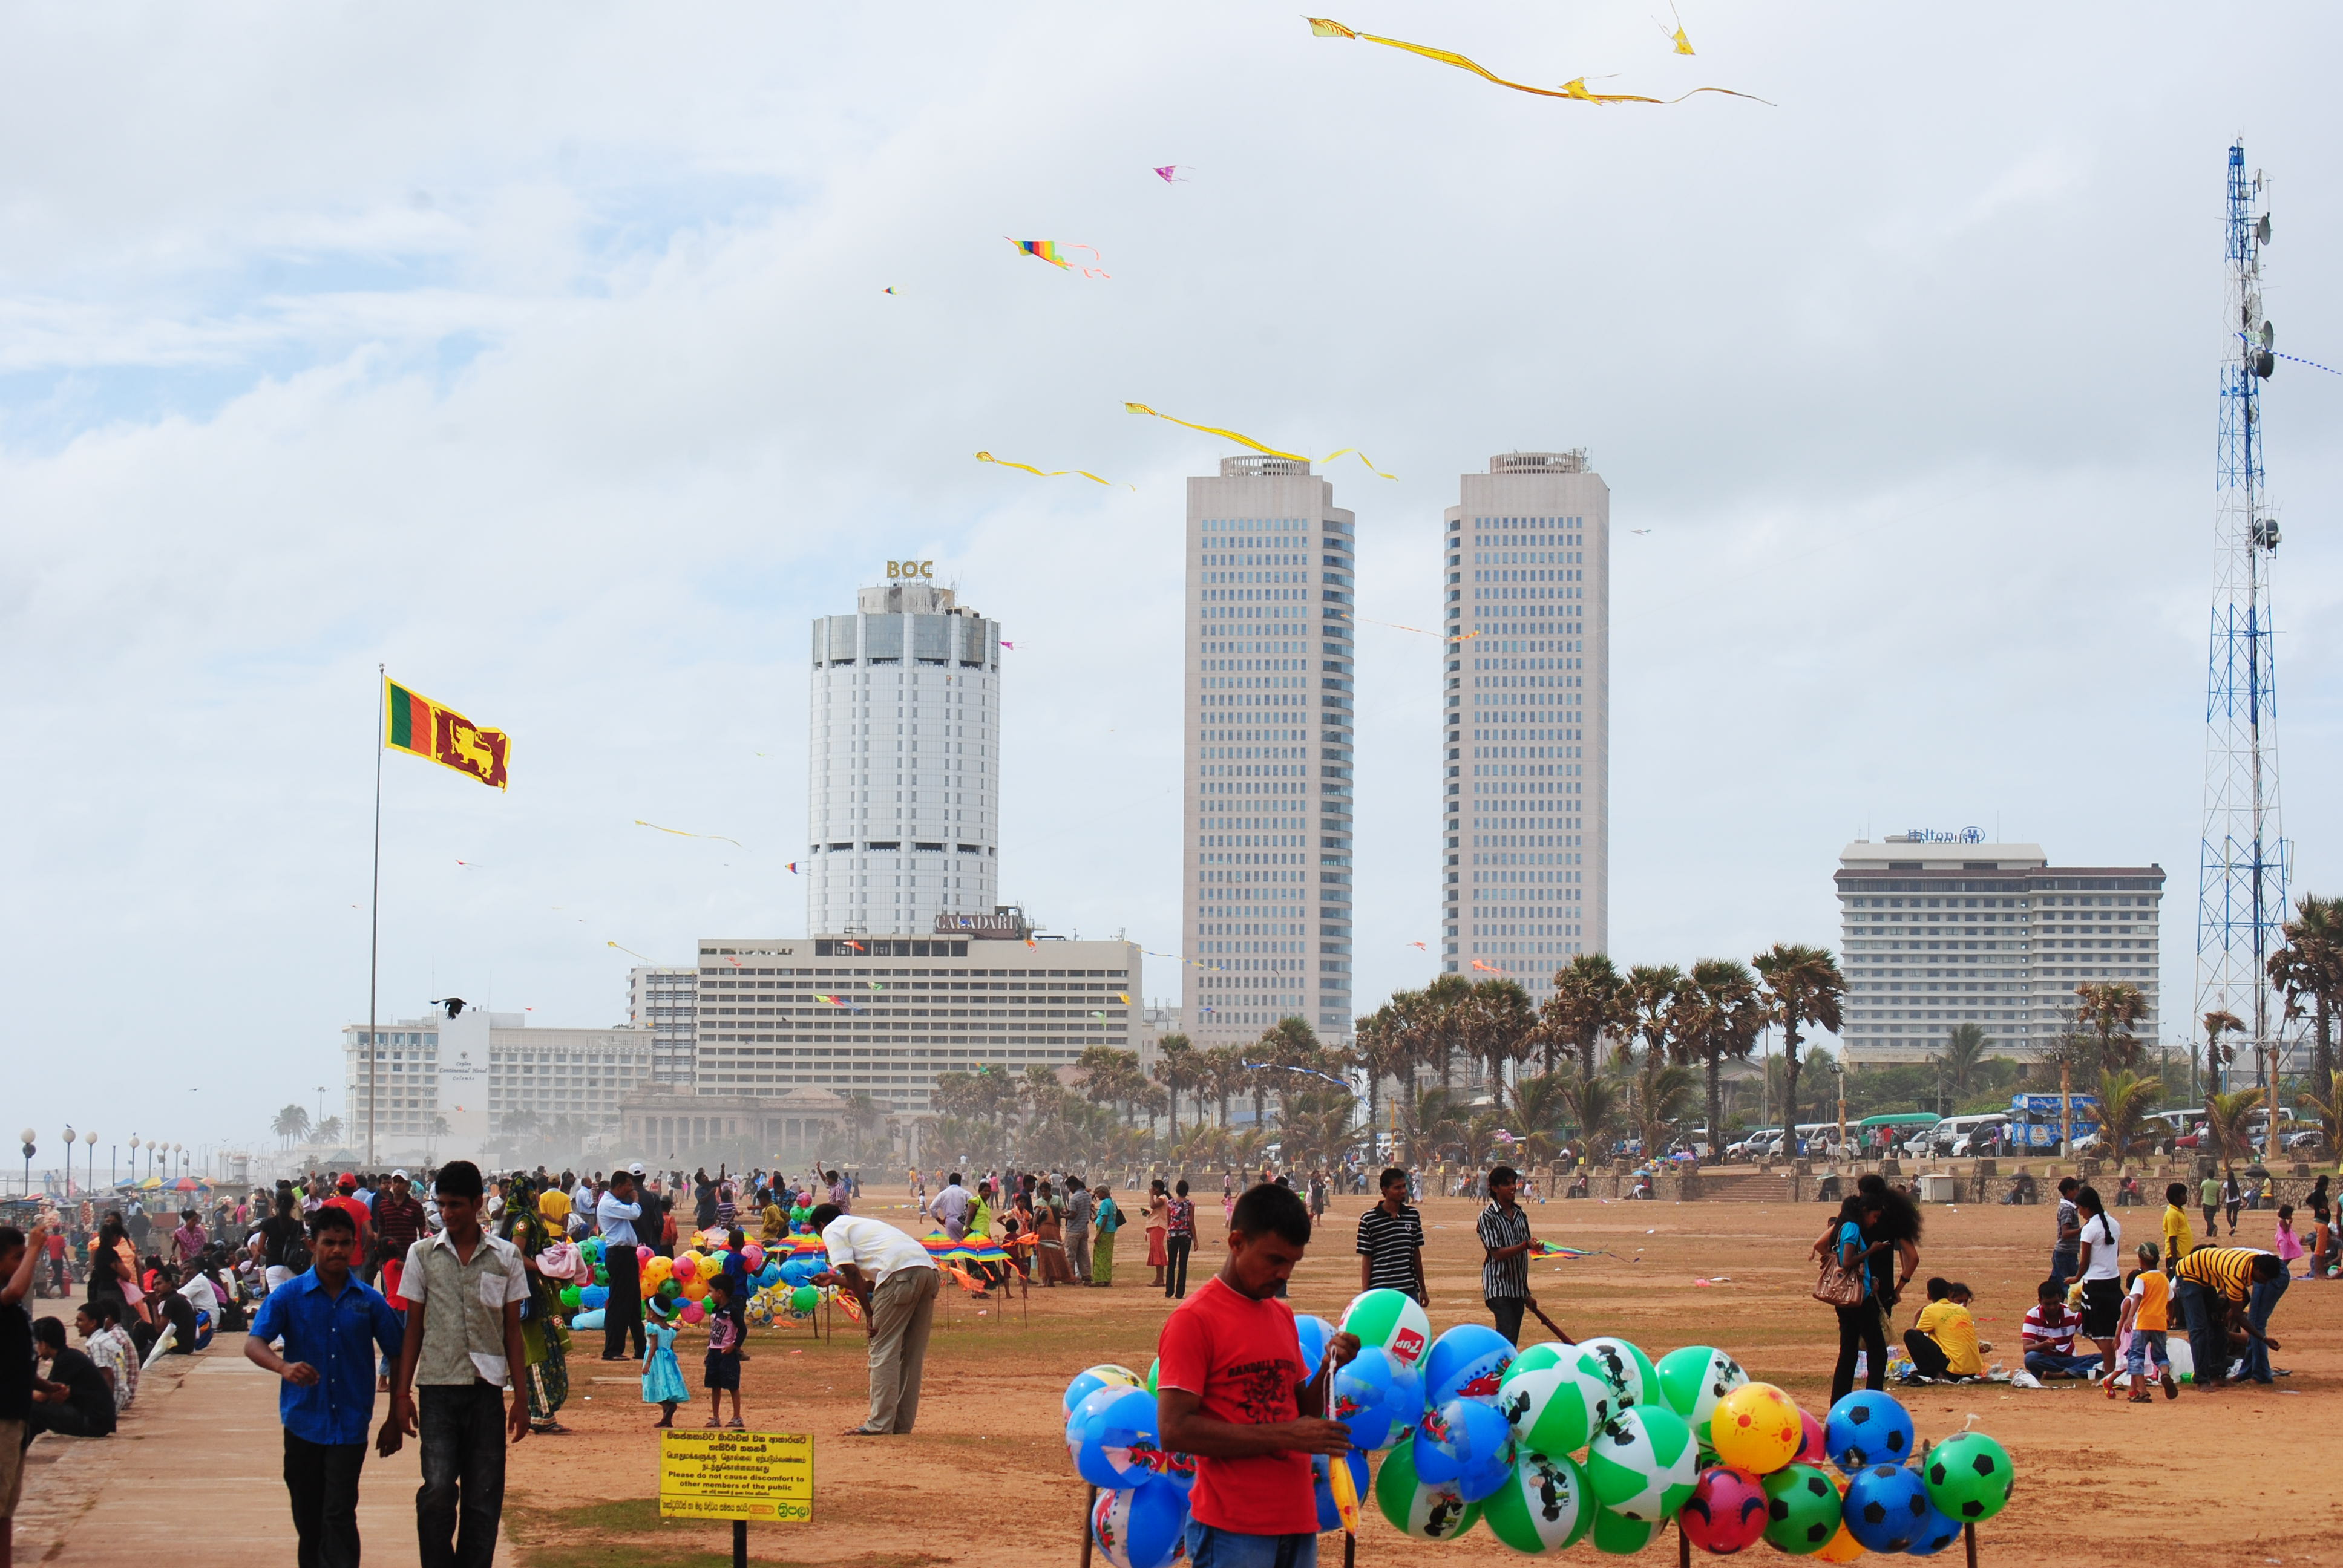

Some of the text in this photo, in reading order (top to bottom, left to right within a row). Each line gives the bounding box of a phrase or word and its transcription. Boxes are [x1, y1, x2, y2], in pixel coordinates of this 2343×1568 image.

[887, 561, 933, 578] BOC
[1908, 828, 1953, 841] Hilton
[1395, 1339, 1422, 1354] 7UP
